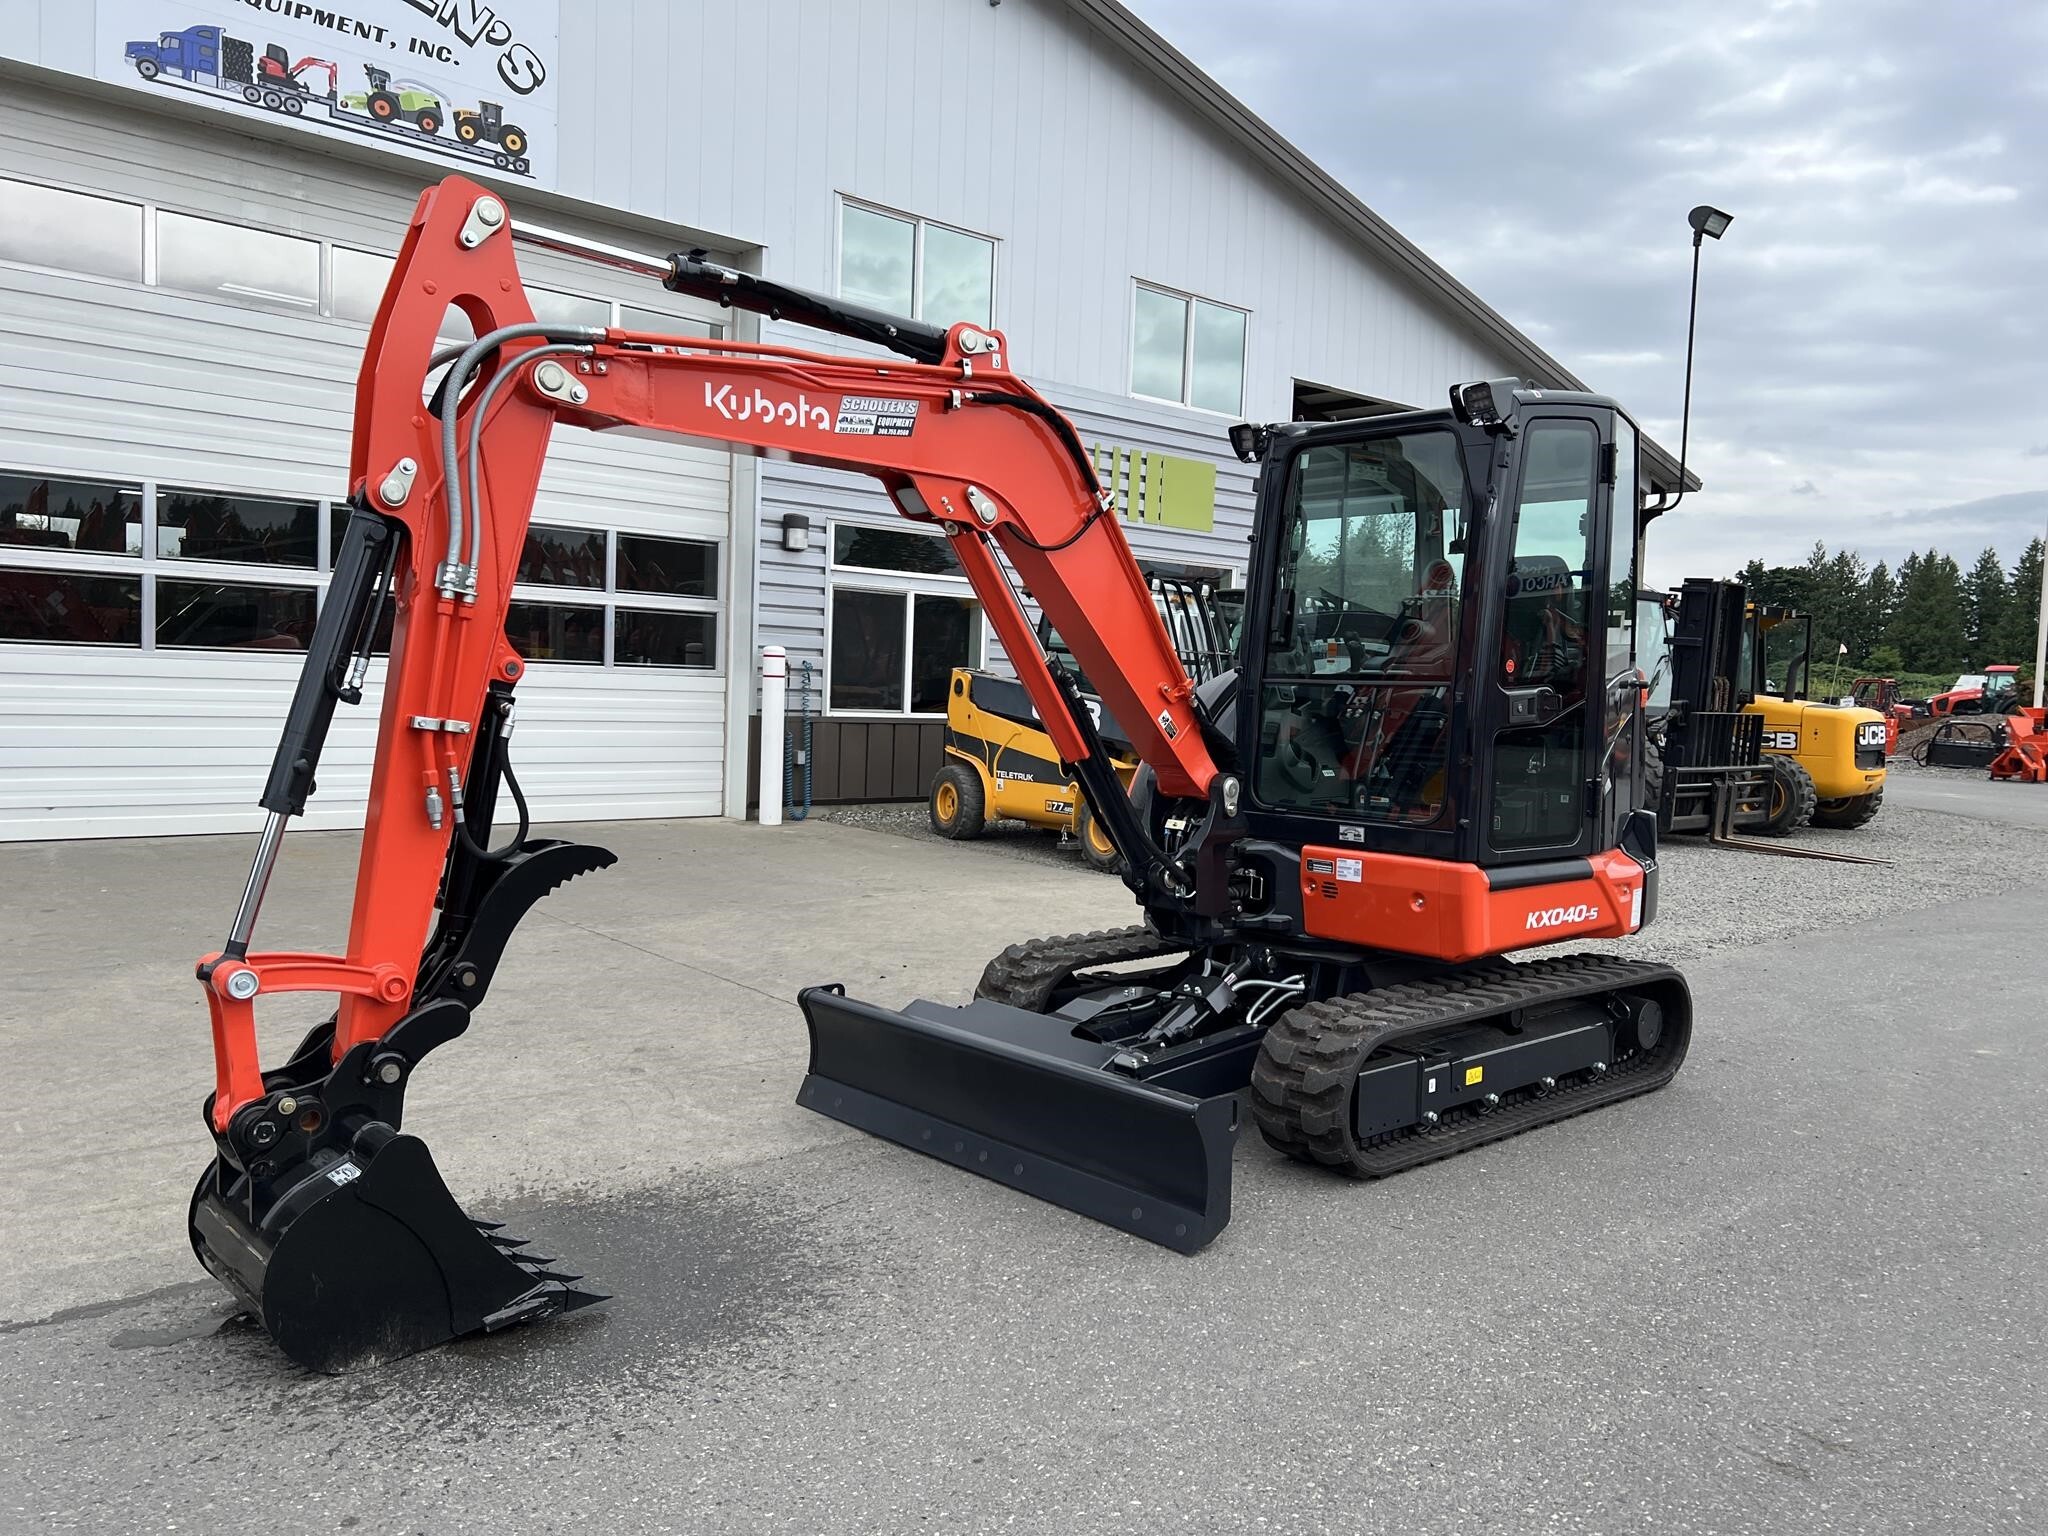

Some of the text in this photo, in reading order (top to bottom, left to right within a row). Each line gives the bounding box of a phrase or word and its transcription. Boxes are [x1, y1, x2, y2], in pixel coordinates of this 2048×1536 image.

[234, 0, 460, 66] QUIPMENT, INC.
[704, 381, 830, 430] Kubota
[842, 398, 917, 415] SCHOLTEN'S
[877, 416, 914, 428] EQUIPMENT
[1859, 725, 1886, 746] JCB
[996, 770, 1034, 782] TELETRUK
[1525, 904, 1598, 929] KX040-5
